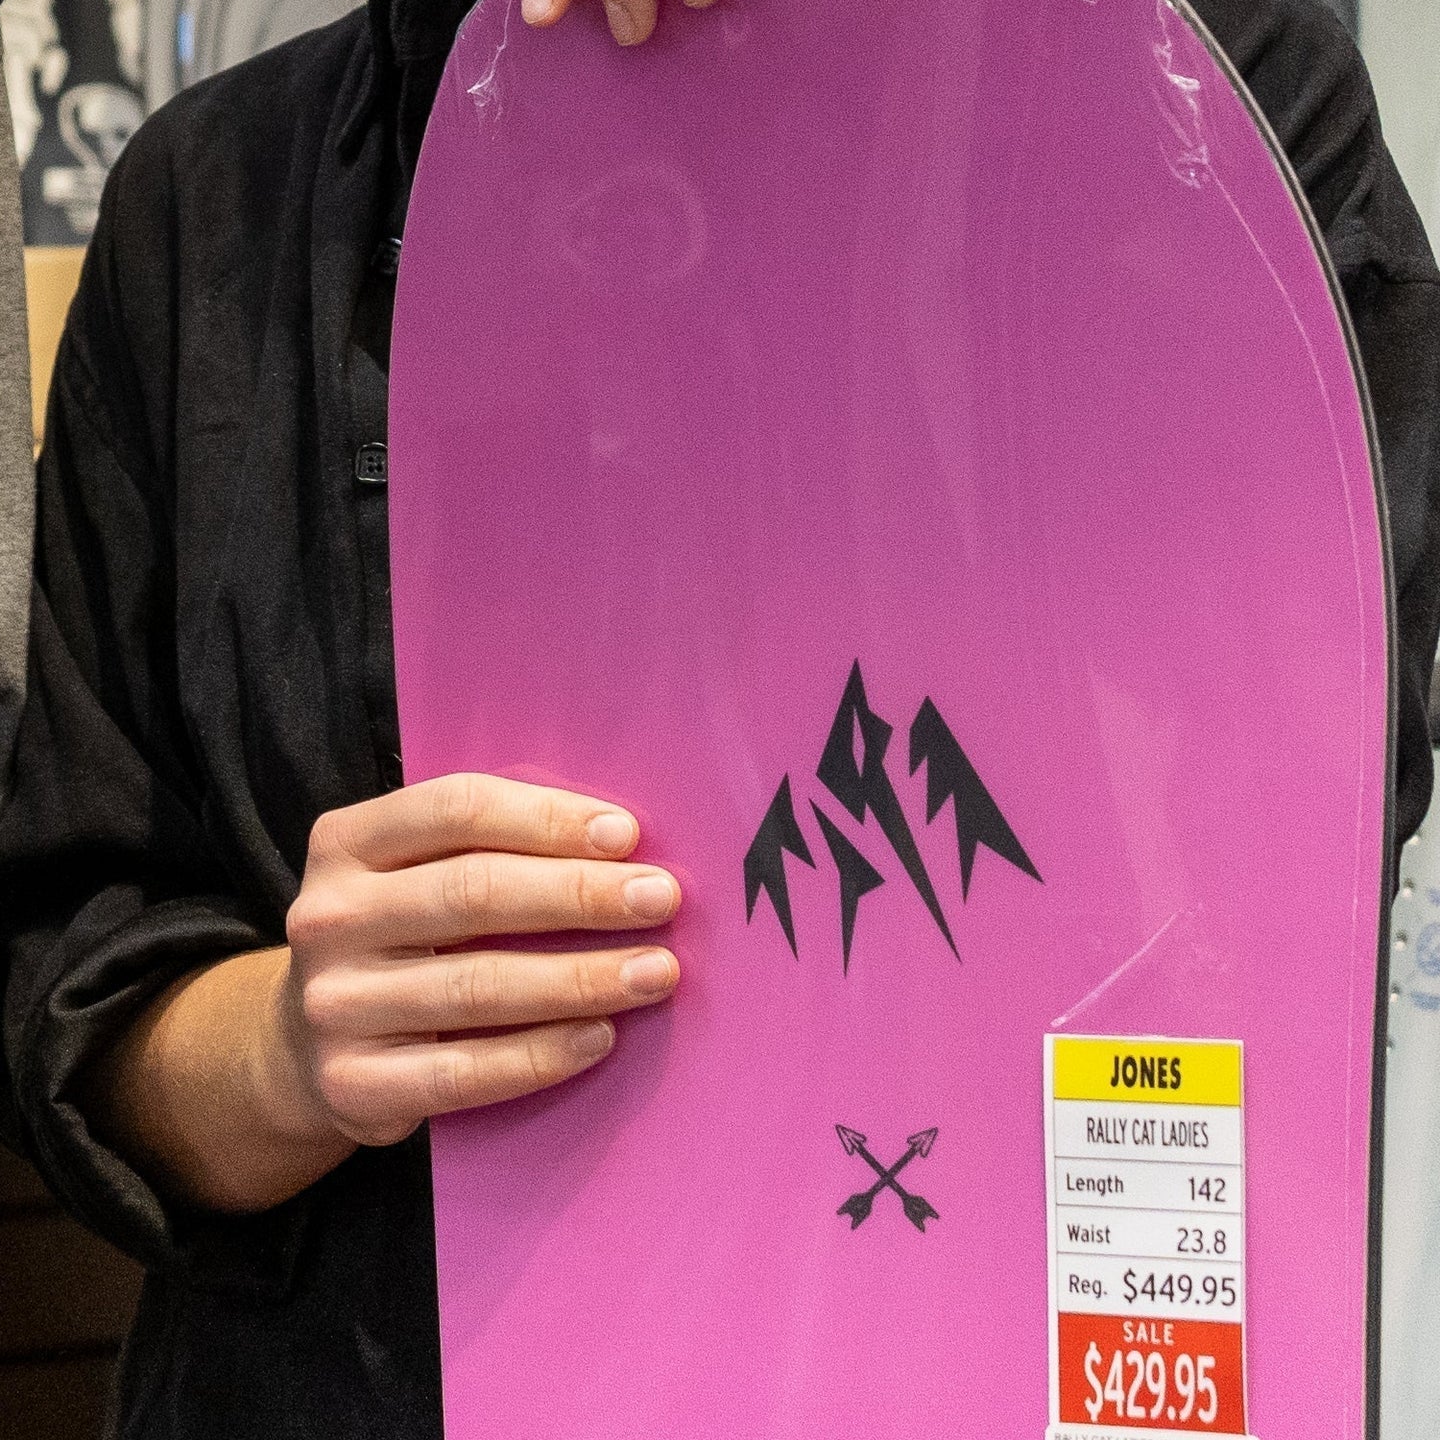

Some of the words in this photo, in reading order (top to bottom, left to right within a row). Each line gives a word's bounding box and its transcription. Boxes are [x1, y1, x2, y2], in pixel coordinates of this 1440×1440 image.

[1110, 1055, 1182, 1090] JONES
[1086, 1116, 1126, 1145] RALLY
[1131, 1119, 1156, 1147] CAT
[1160, 1121, 1209, 1149] LADIES
[1066, 1173, 1124, 1197] Length
[1188, 1177, 1226, 1203] 142
[1066, 1223, 1111, 1245] Waist
[1177, 1227, 1227, 1255] 23.8
[1069, 1274, 1108, 1299] Reg.
[1123, 1269, 1236, 1308] $449.95
[1123, 1321, 1175, 1345] SALE
[1084, 1342, 1218, 1423] $429.95
